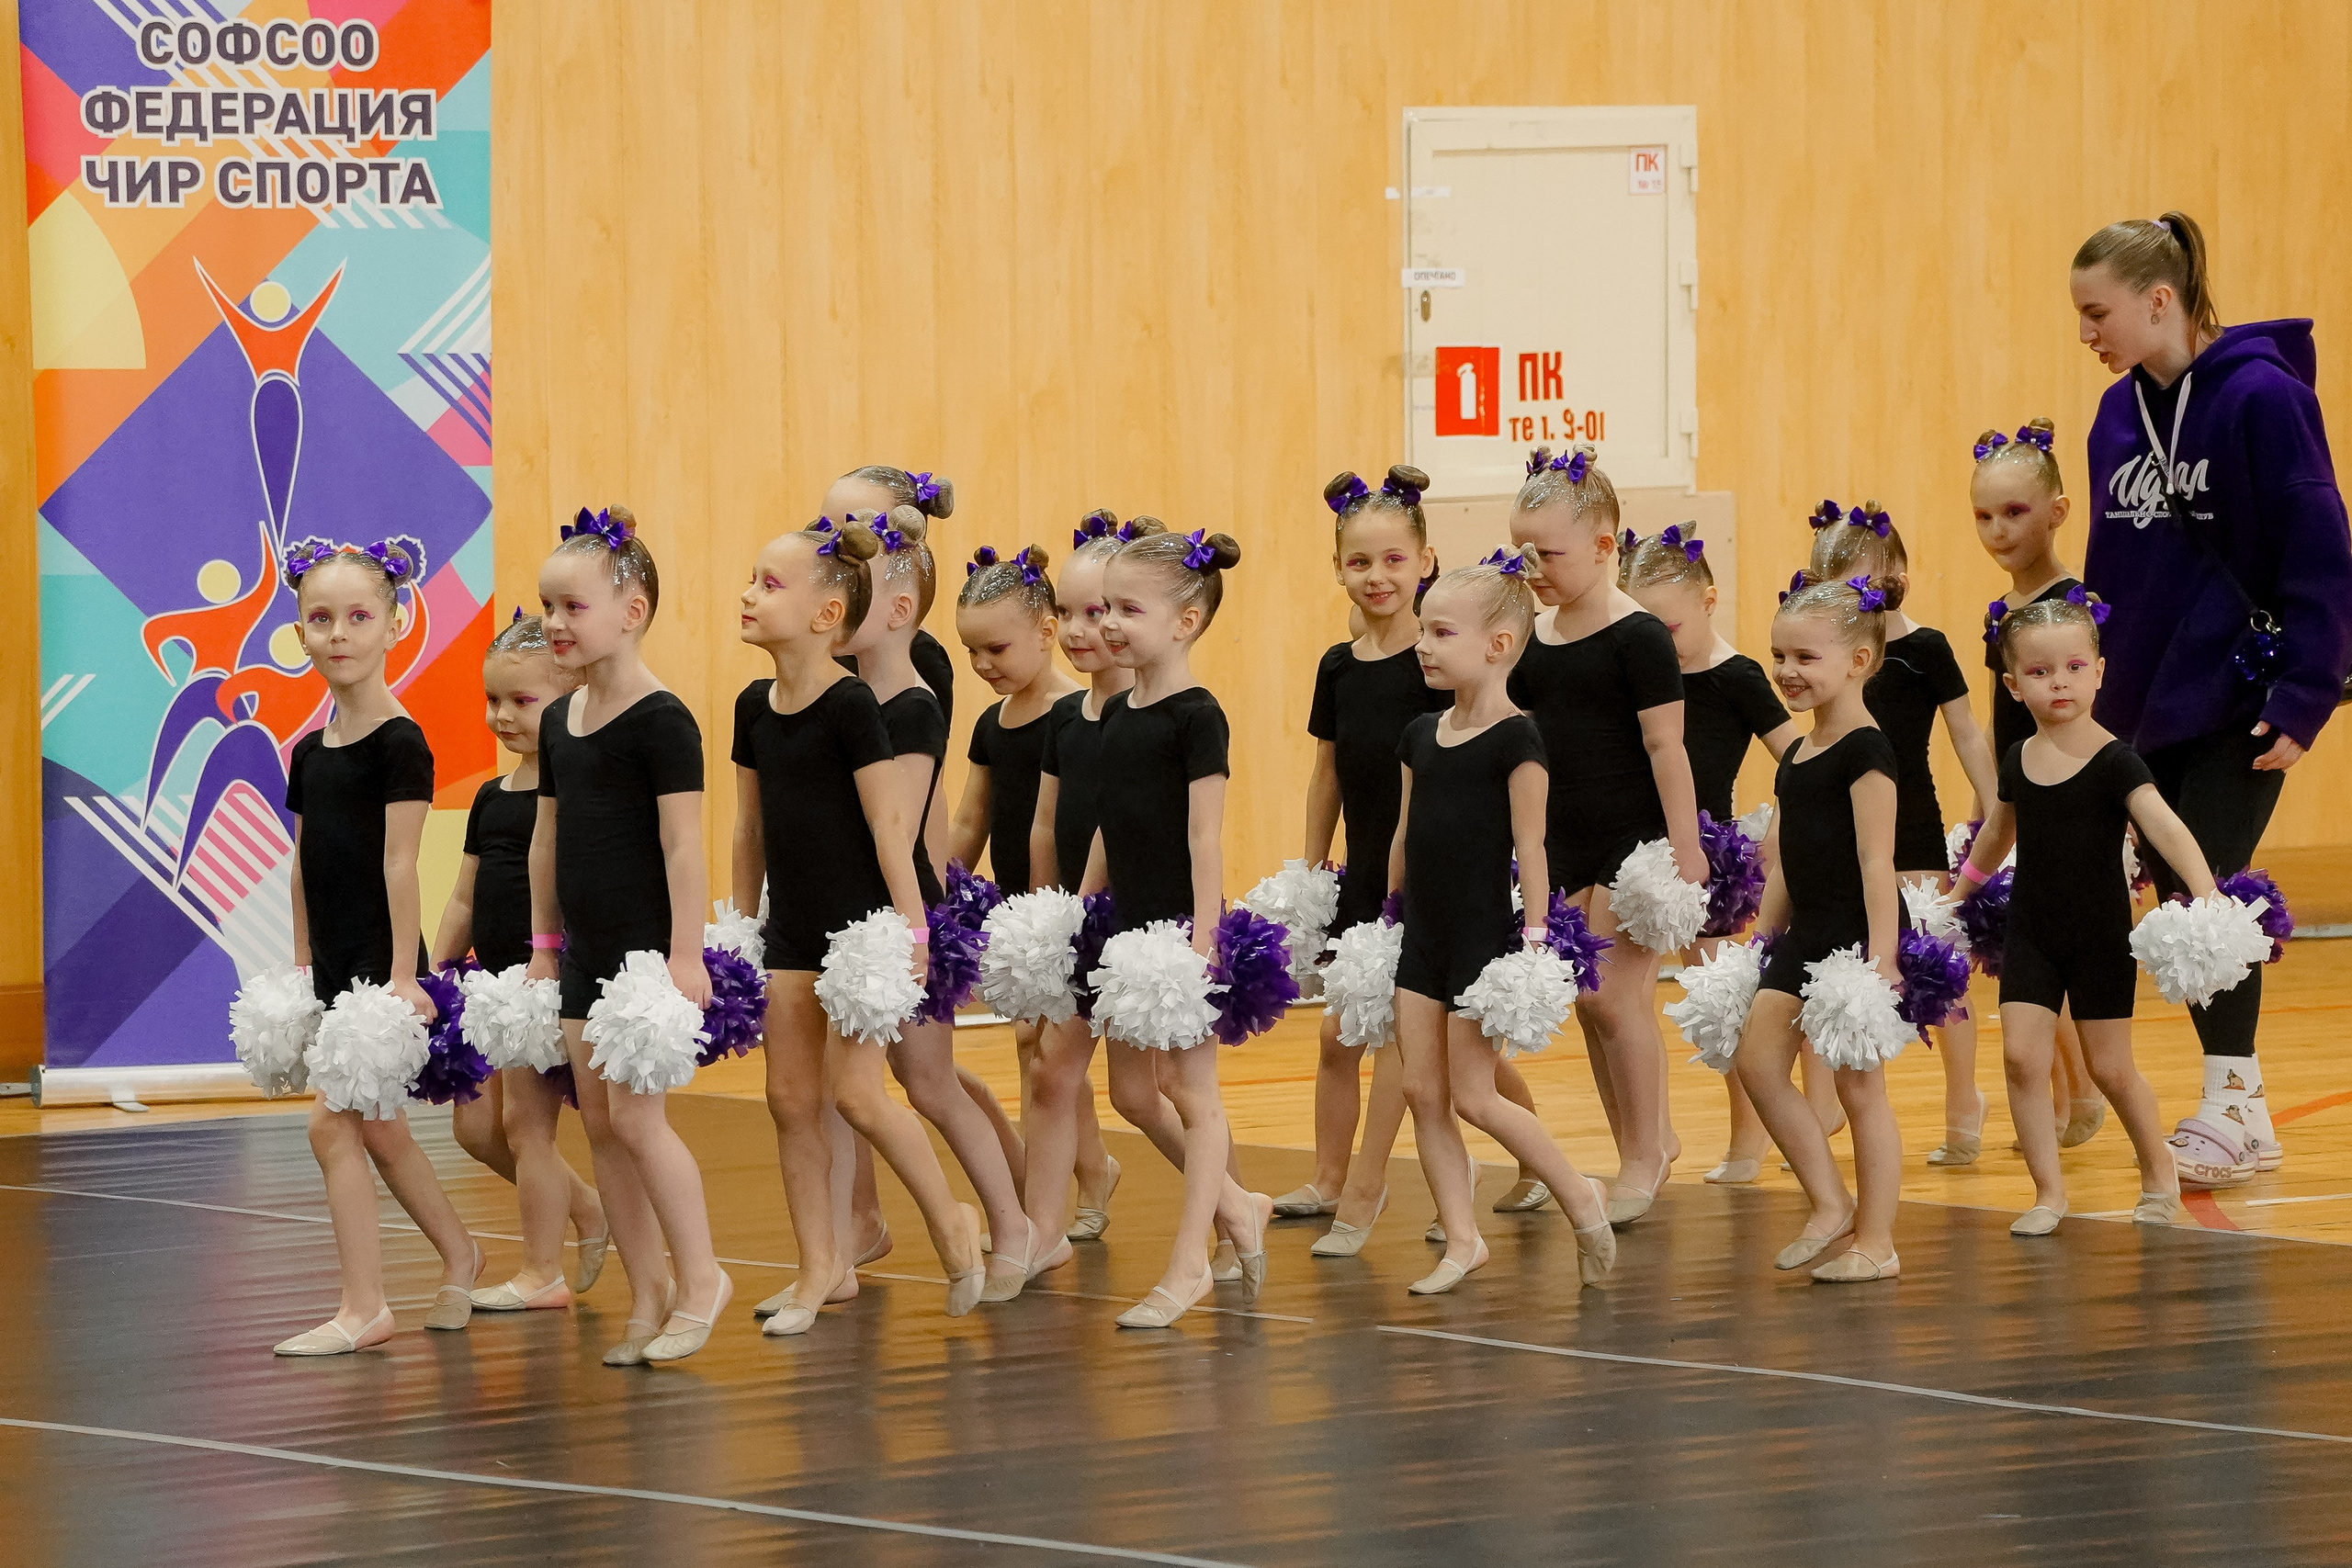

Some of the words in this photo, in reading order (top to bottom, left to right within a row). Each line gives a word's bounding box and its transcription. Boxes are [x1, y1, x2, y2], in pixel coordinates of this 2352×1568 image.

[141, 20, 375, 67] СОФСОО
[85, 89, 434, 142] ФЕДЕРАЦИЯ
[85, 160, 201, 204] ЧИР
[219, 162, 437, 205] СПОРТА
[1635, 152, 1659, 172] ПК
[1519, 352, 1565, 401] ПК
